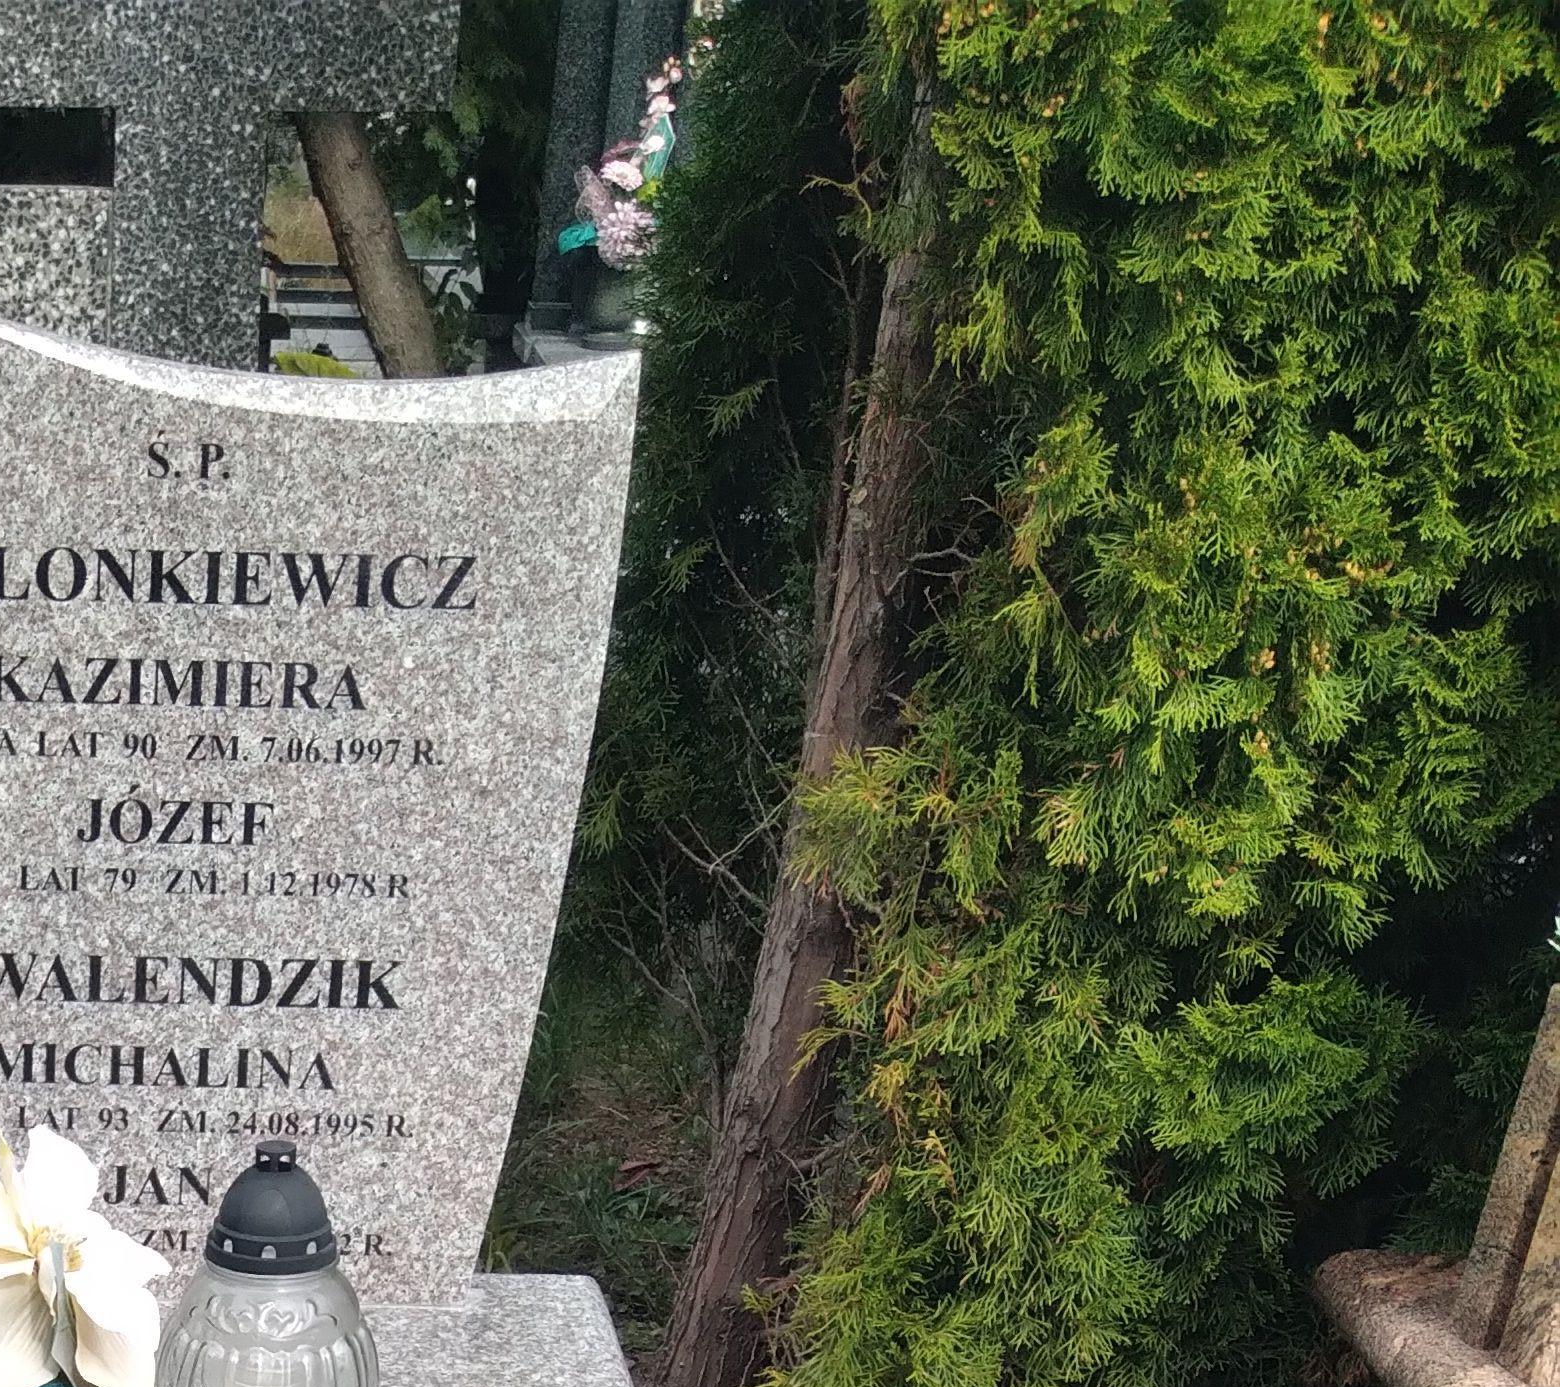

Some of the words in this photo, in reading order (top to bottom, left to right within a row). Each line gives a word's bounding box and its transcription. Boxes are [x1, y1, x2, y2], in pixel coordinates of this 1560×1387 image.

[148, 430, 181, 479] Ś.
[200, 443, 230, 479] P.
[38, 731, 104, 758] LAT
[123, 733, 157, 759] 90
[186, 734, 248, 762] ZM.
[261, 736, 401, 764] 7.06.1997
[413, 738, 442, 766] R.
[77, 784, 275, 845] JÓZEF
[20, 864, 85, 892] LAT
[104, 867, 137, 893] 79
[165, 868, 226, 895] ZM.
[16, 1106, 81, 1131] LAT
[98, 1107, 129, 1132] 93
[157, 1109, 215, 1134] ZM.
[226, 1110, 375, 1138] 24.08.1995
[386, 1114, 414, 1138] R.
[103, 1164, 212, 1207] JAN
[364, 1234, 393, 1256] R.
